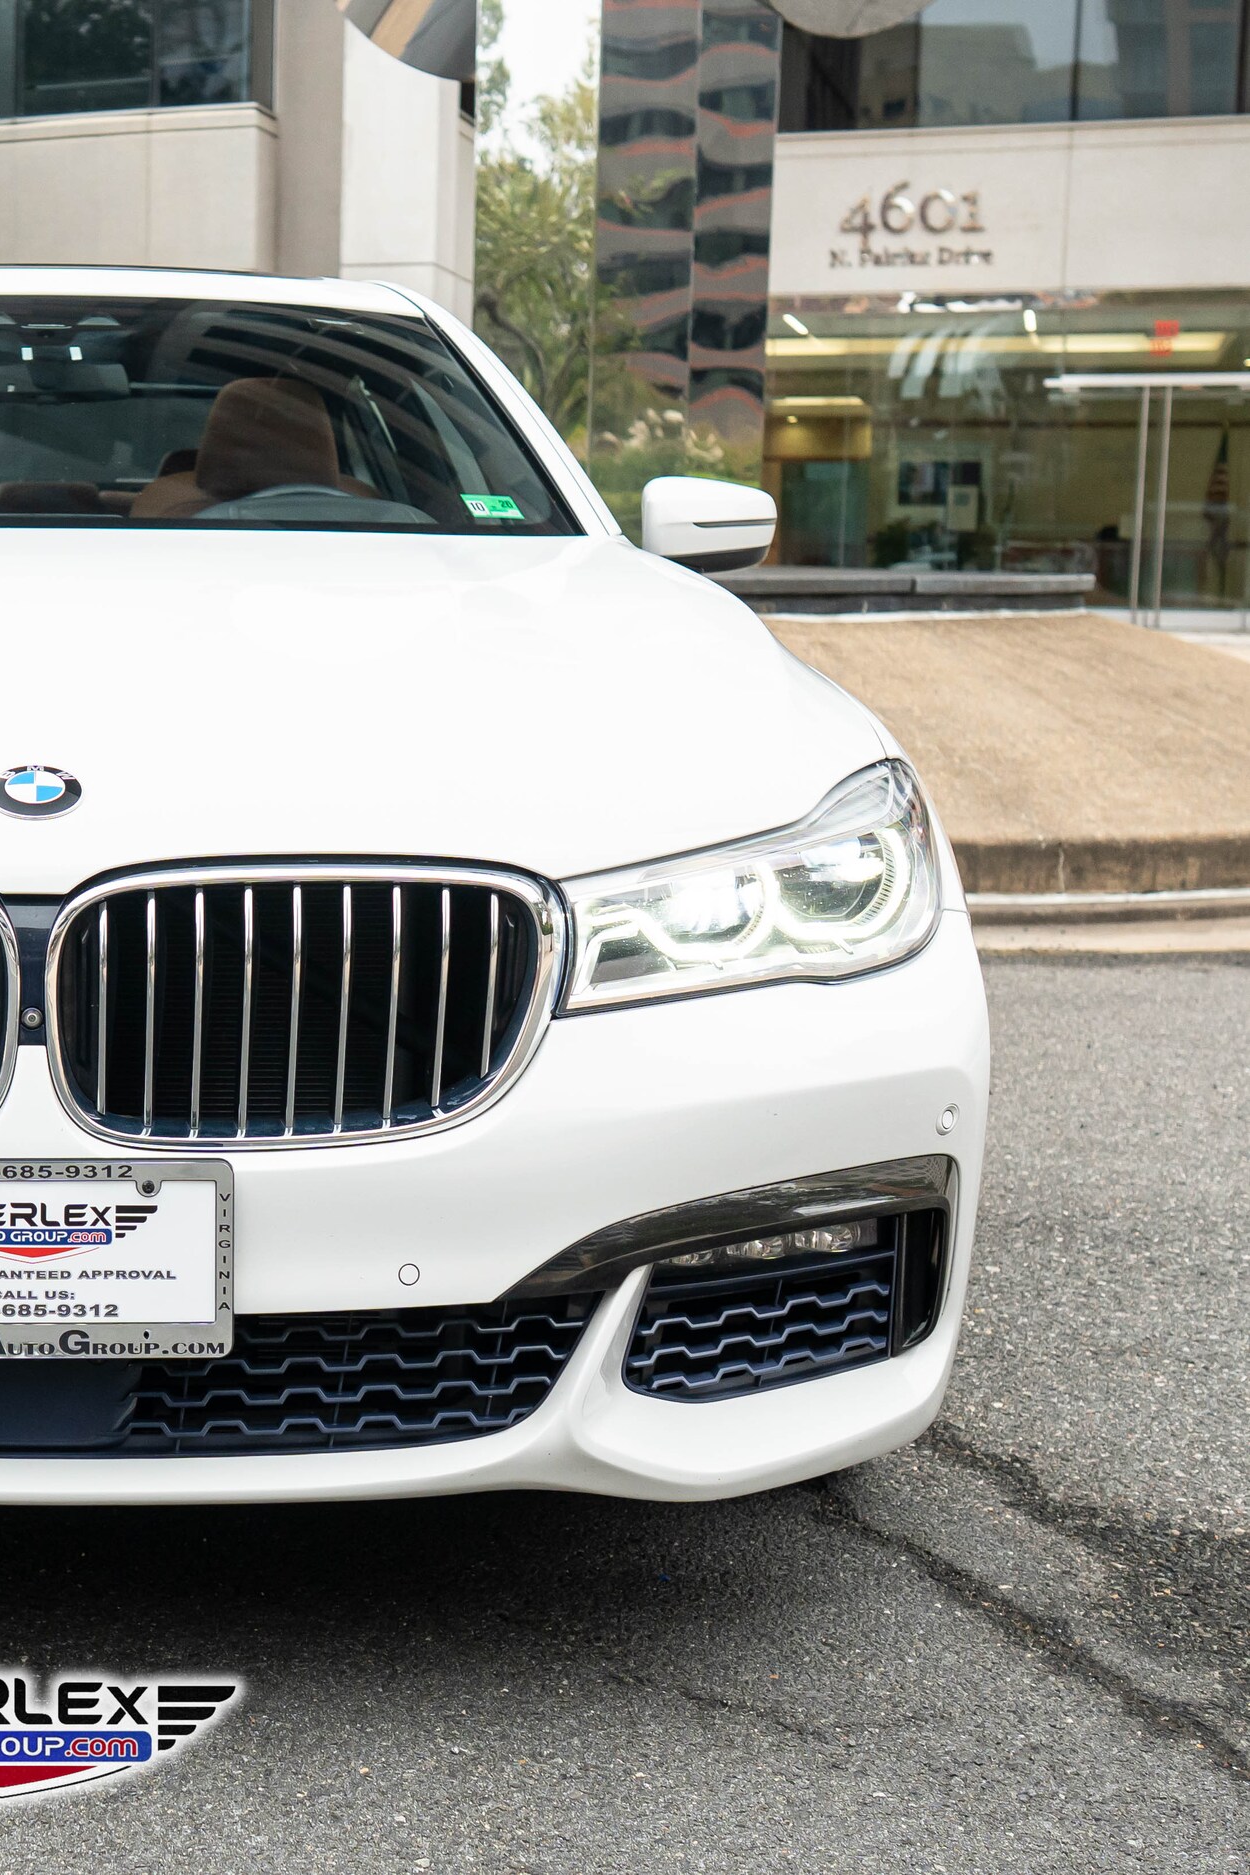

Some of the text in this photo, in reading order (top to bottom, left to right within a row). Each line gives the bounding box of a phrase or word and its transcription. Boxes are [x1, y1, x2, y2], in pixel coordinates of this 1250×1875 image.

[839, 179, 986, 249] 4601
[10, 1231, 107, 1243] GROUP.com
[218, 1193, 231, 1311] VIRGINIA
[77, 1270, 177, 1280] APPROVAL
[44, 1290, 76, 1301] US:
